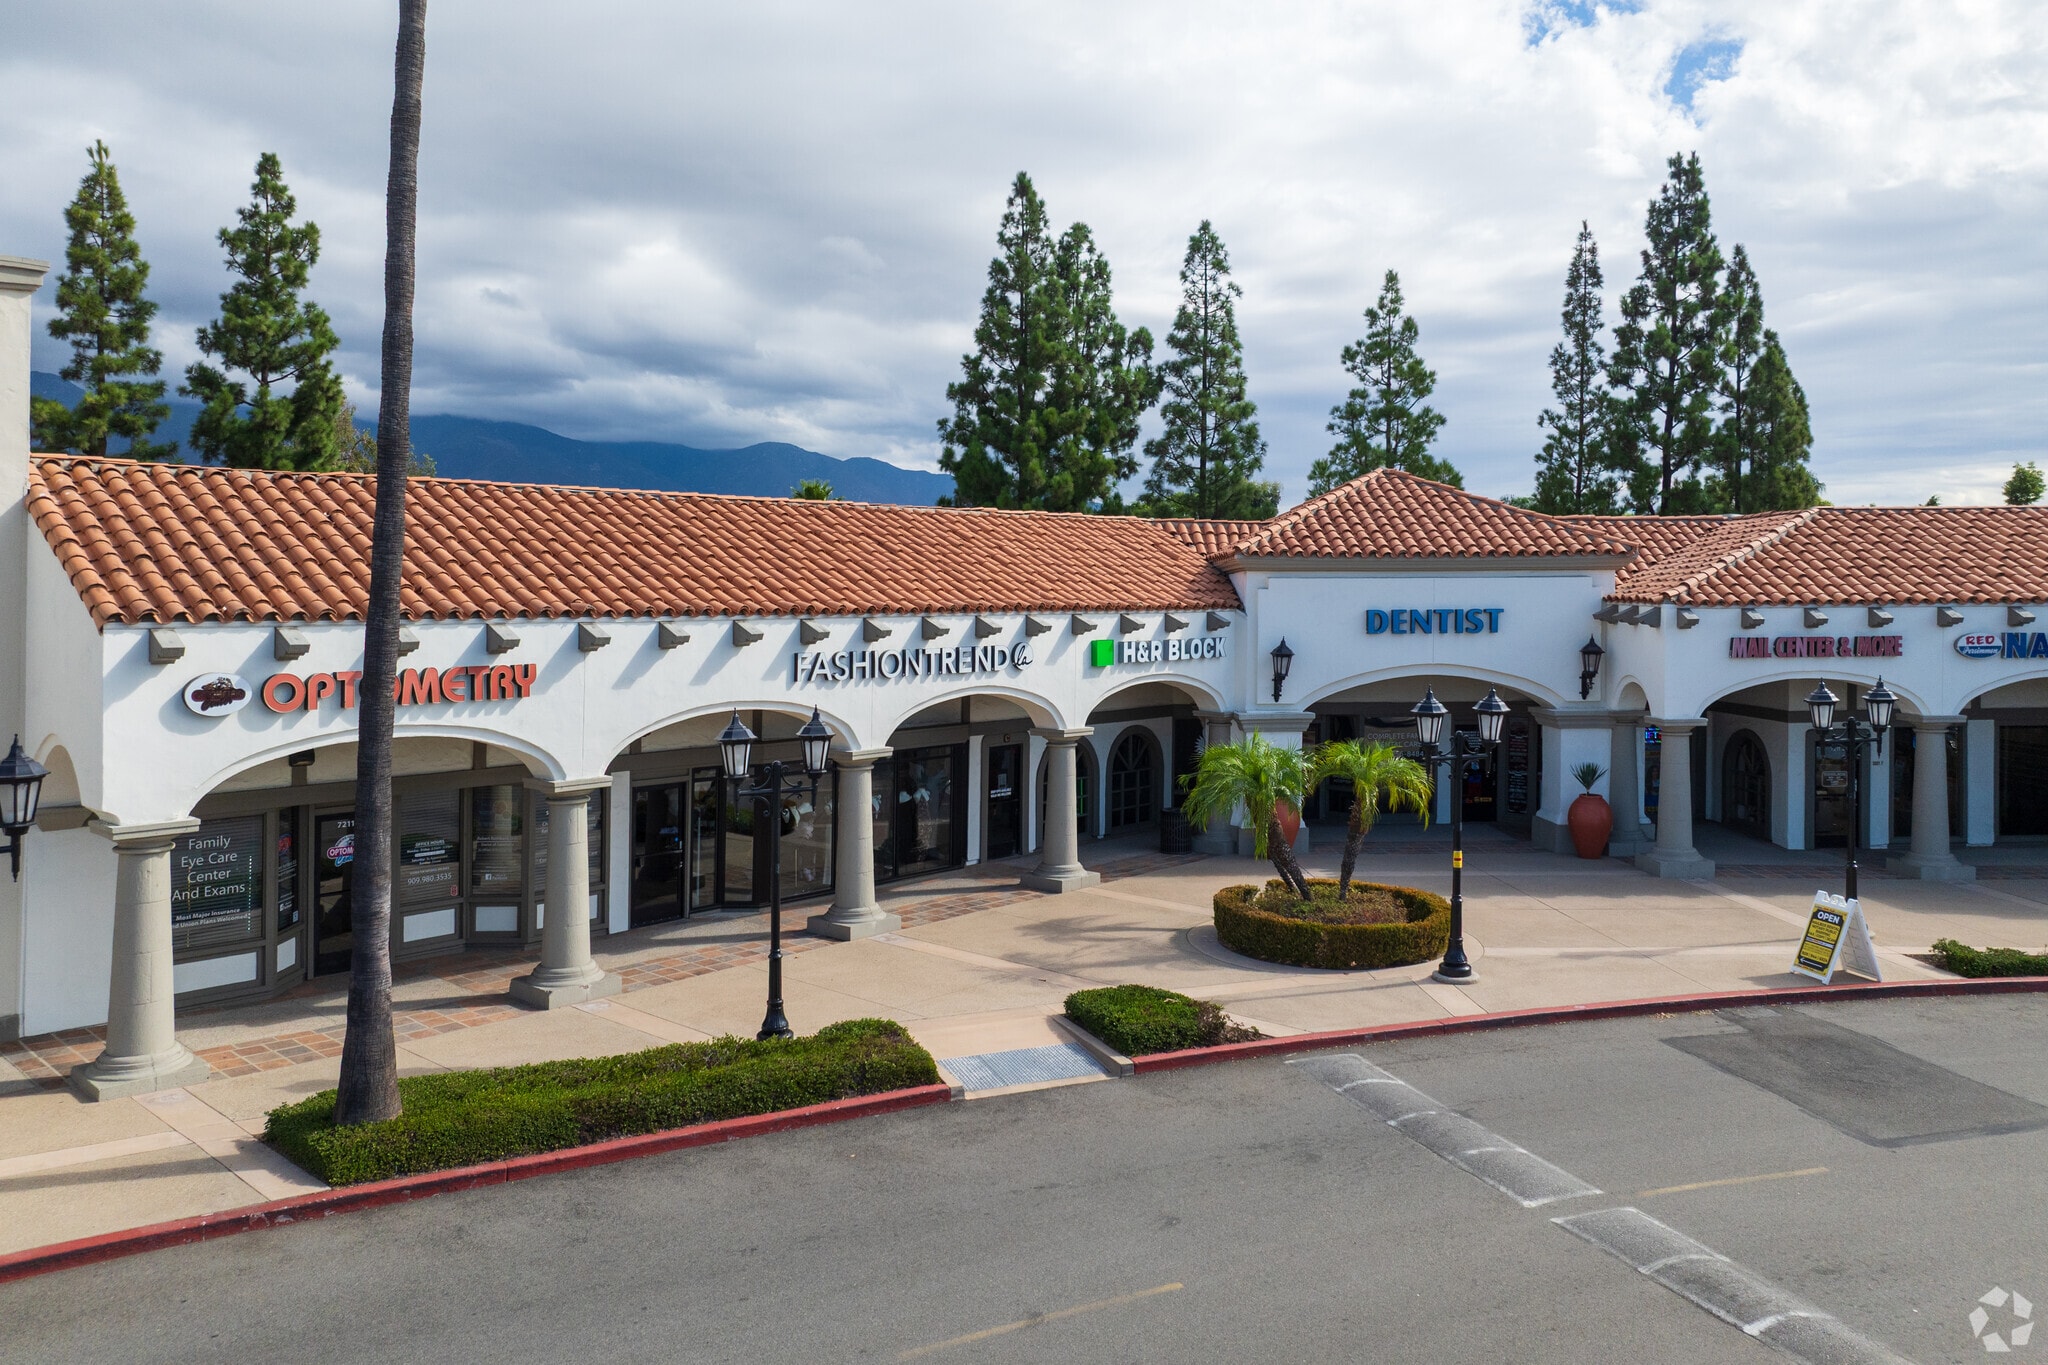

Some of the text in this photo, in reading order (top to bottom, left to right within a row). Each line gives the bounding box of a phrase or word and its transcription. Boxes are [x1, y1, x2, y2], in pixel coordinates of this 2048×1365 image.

[1366, 608, 1504, 634] DENTIST
[1730, 635, 1903, 658] MAIL CENTER & MORE
[1965, 635, 1996, 645] RED
[1120, 637, 1226, 663] H&R BLOCK
[794, 645, 1009, 682] FASHIONTREND
[263, 663, 537, 714] OPTMETRY
[1367, 732, 1406, 740] COMPLETE
[337, 820, 355, 829] 7211
[188, 835, 231, 850] Family
[181, 853, 238, 869] Eye Care
[187, 869, 232, 883] Center
[172, 884, 246, 901] And Exams
[192, 911, 210, 919] Major
[211, 908, 240, 916] Insurance
[217, 913, 248, 922] Welcomed
[1817, 911, 1840, 924] OPEN
